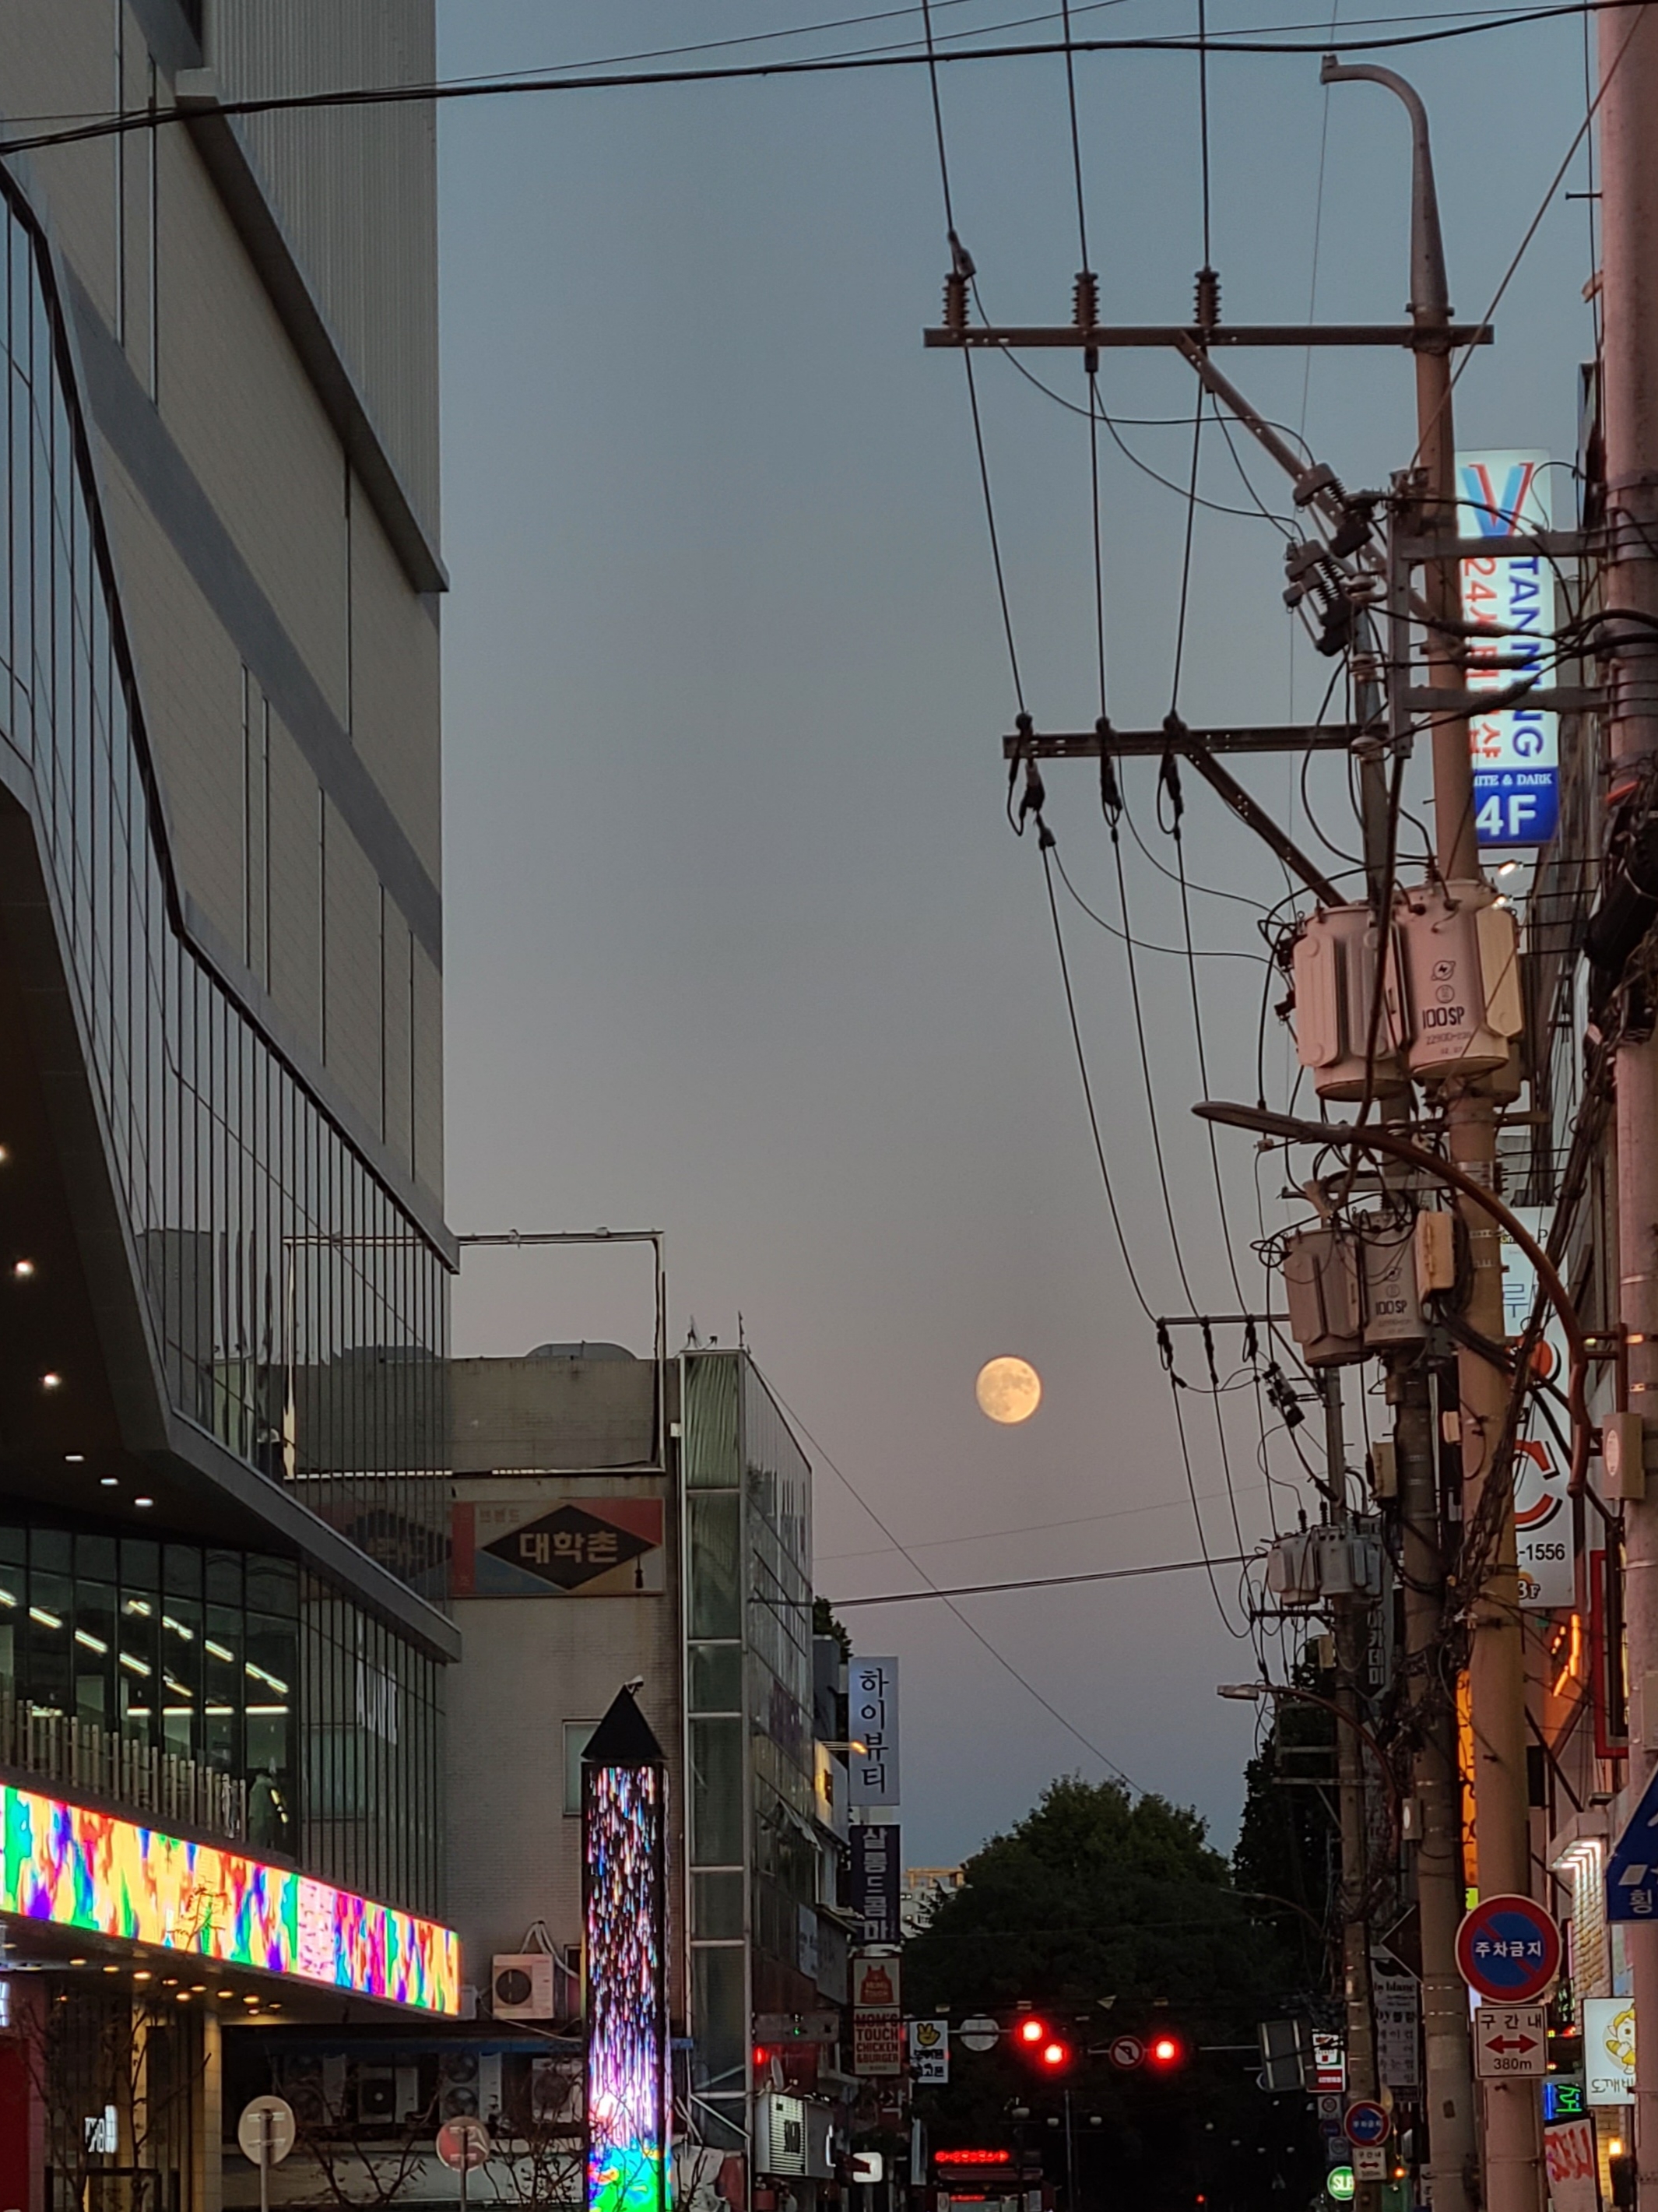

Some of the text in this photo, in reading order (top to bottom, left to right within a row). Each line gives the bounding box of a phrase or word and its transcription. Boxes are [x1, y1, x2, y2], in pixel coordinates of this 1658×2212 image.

[1516, 772, 1552, 786] DARK
[1475, 794, 1537, 836] 4F
[518, 1530, 617, 1565] 대학촌
[859, 1668, 890, 1794] 하이뷰티
[1474, 1939, 1541, 1958] 주차금지
[856, 2028, 898, 2041] TOUCH
[856, 2042, 898, 2052] CHICKEN
[1493, 2058, 1533, 2070] 380m
